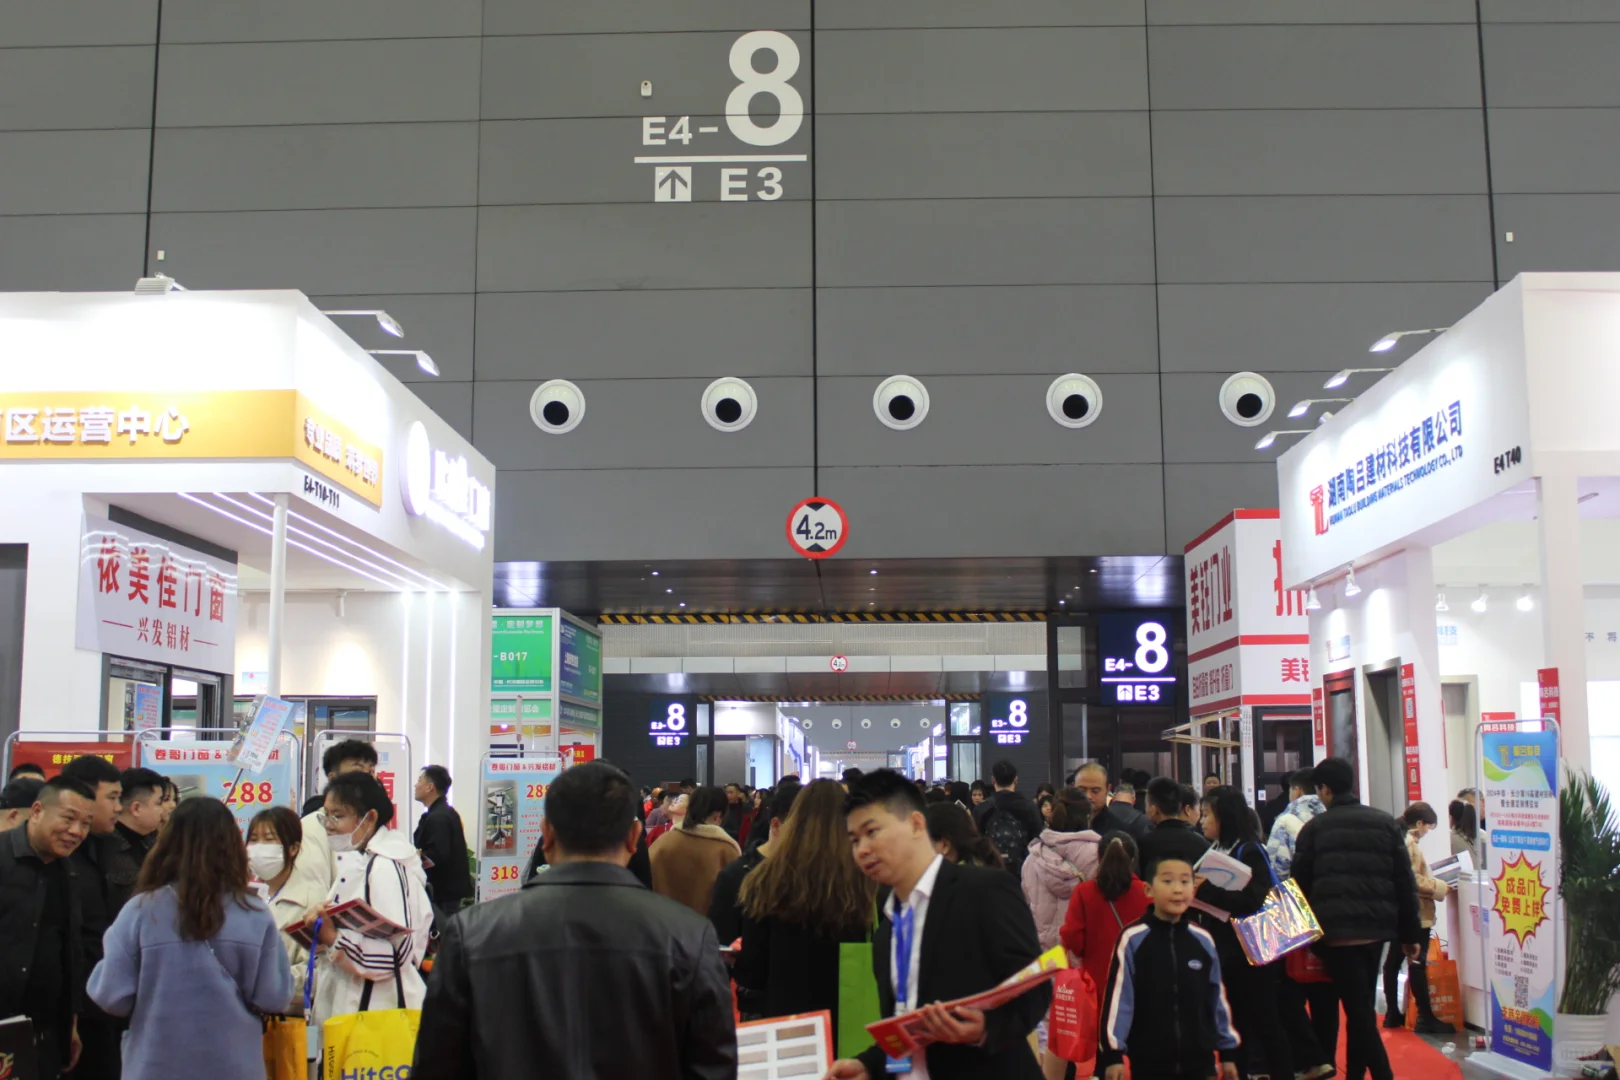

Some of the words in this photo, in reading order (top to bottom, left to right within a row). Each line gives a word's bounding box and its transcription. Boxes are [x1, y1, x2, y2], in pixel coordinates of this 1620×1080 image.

[796, 514, 837, 541] 4.2m
[1135, 685, 1160, 701] E3
[490, 865, 519, 881] 318
[1506, 877, 1536, 897] 成品门
